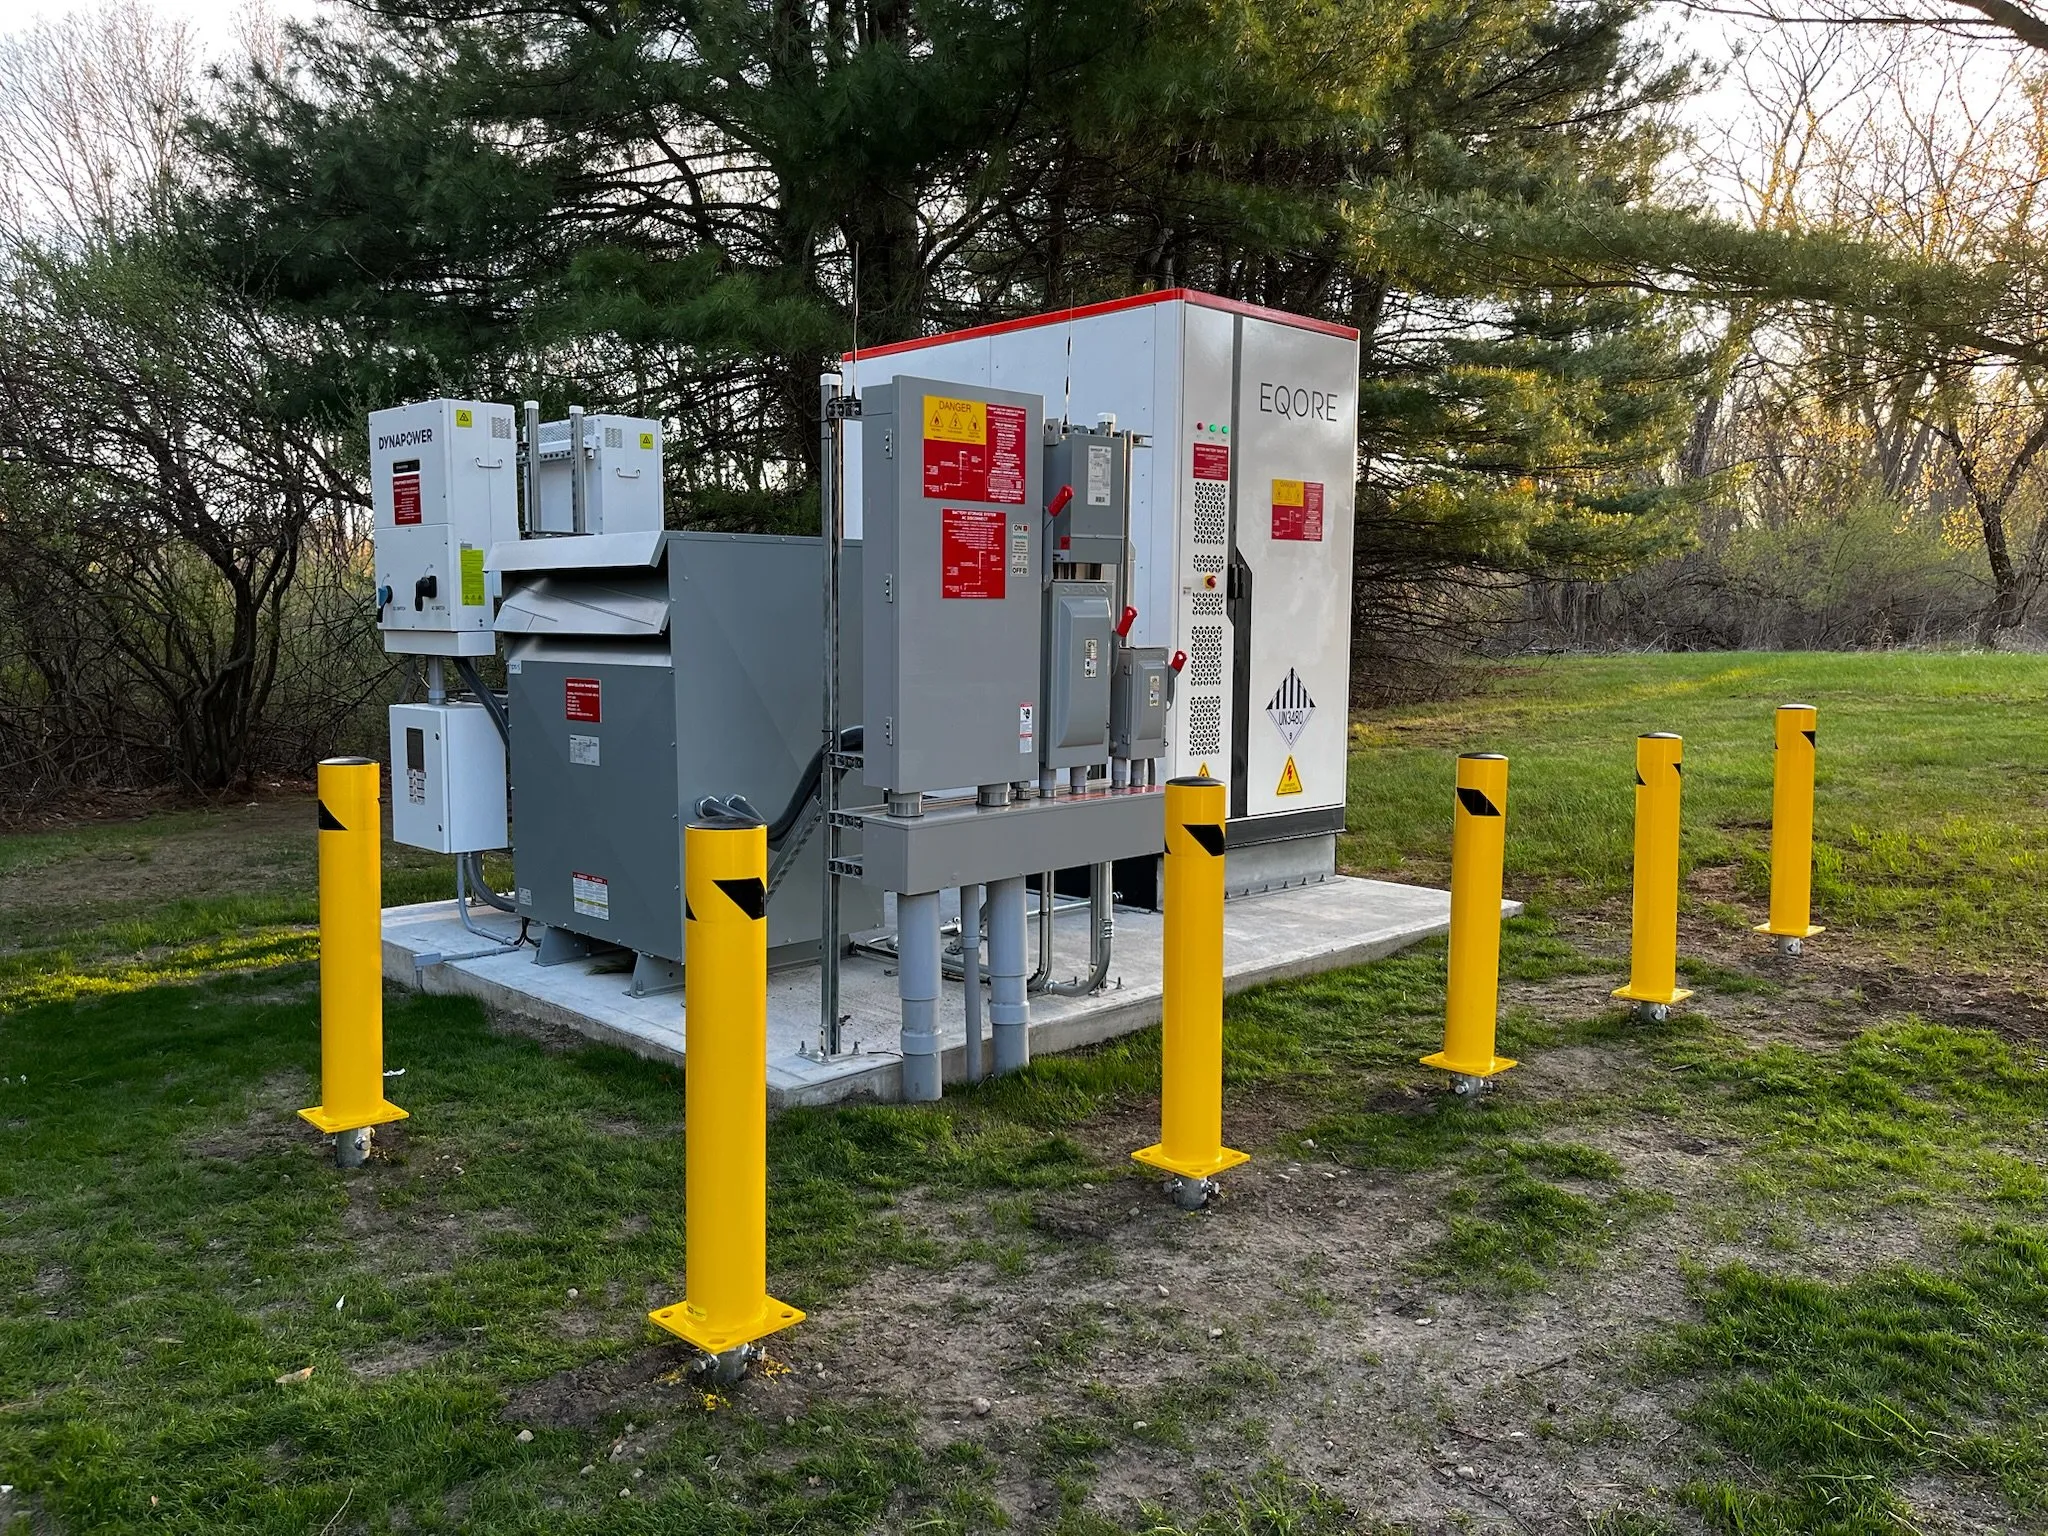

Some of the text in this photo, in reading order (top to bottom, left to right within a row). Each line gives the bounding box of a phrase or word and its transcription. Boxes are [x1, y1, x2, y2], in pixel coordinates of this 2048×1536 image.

[939, 400, 972, 413] DANGER
[1260, 382, 1338, 422] EQORE
[378, 428, 433, 450] DYNAPOWER
[1279, 710, 1303, 726] UN3480
